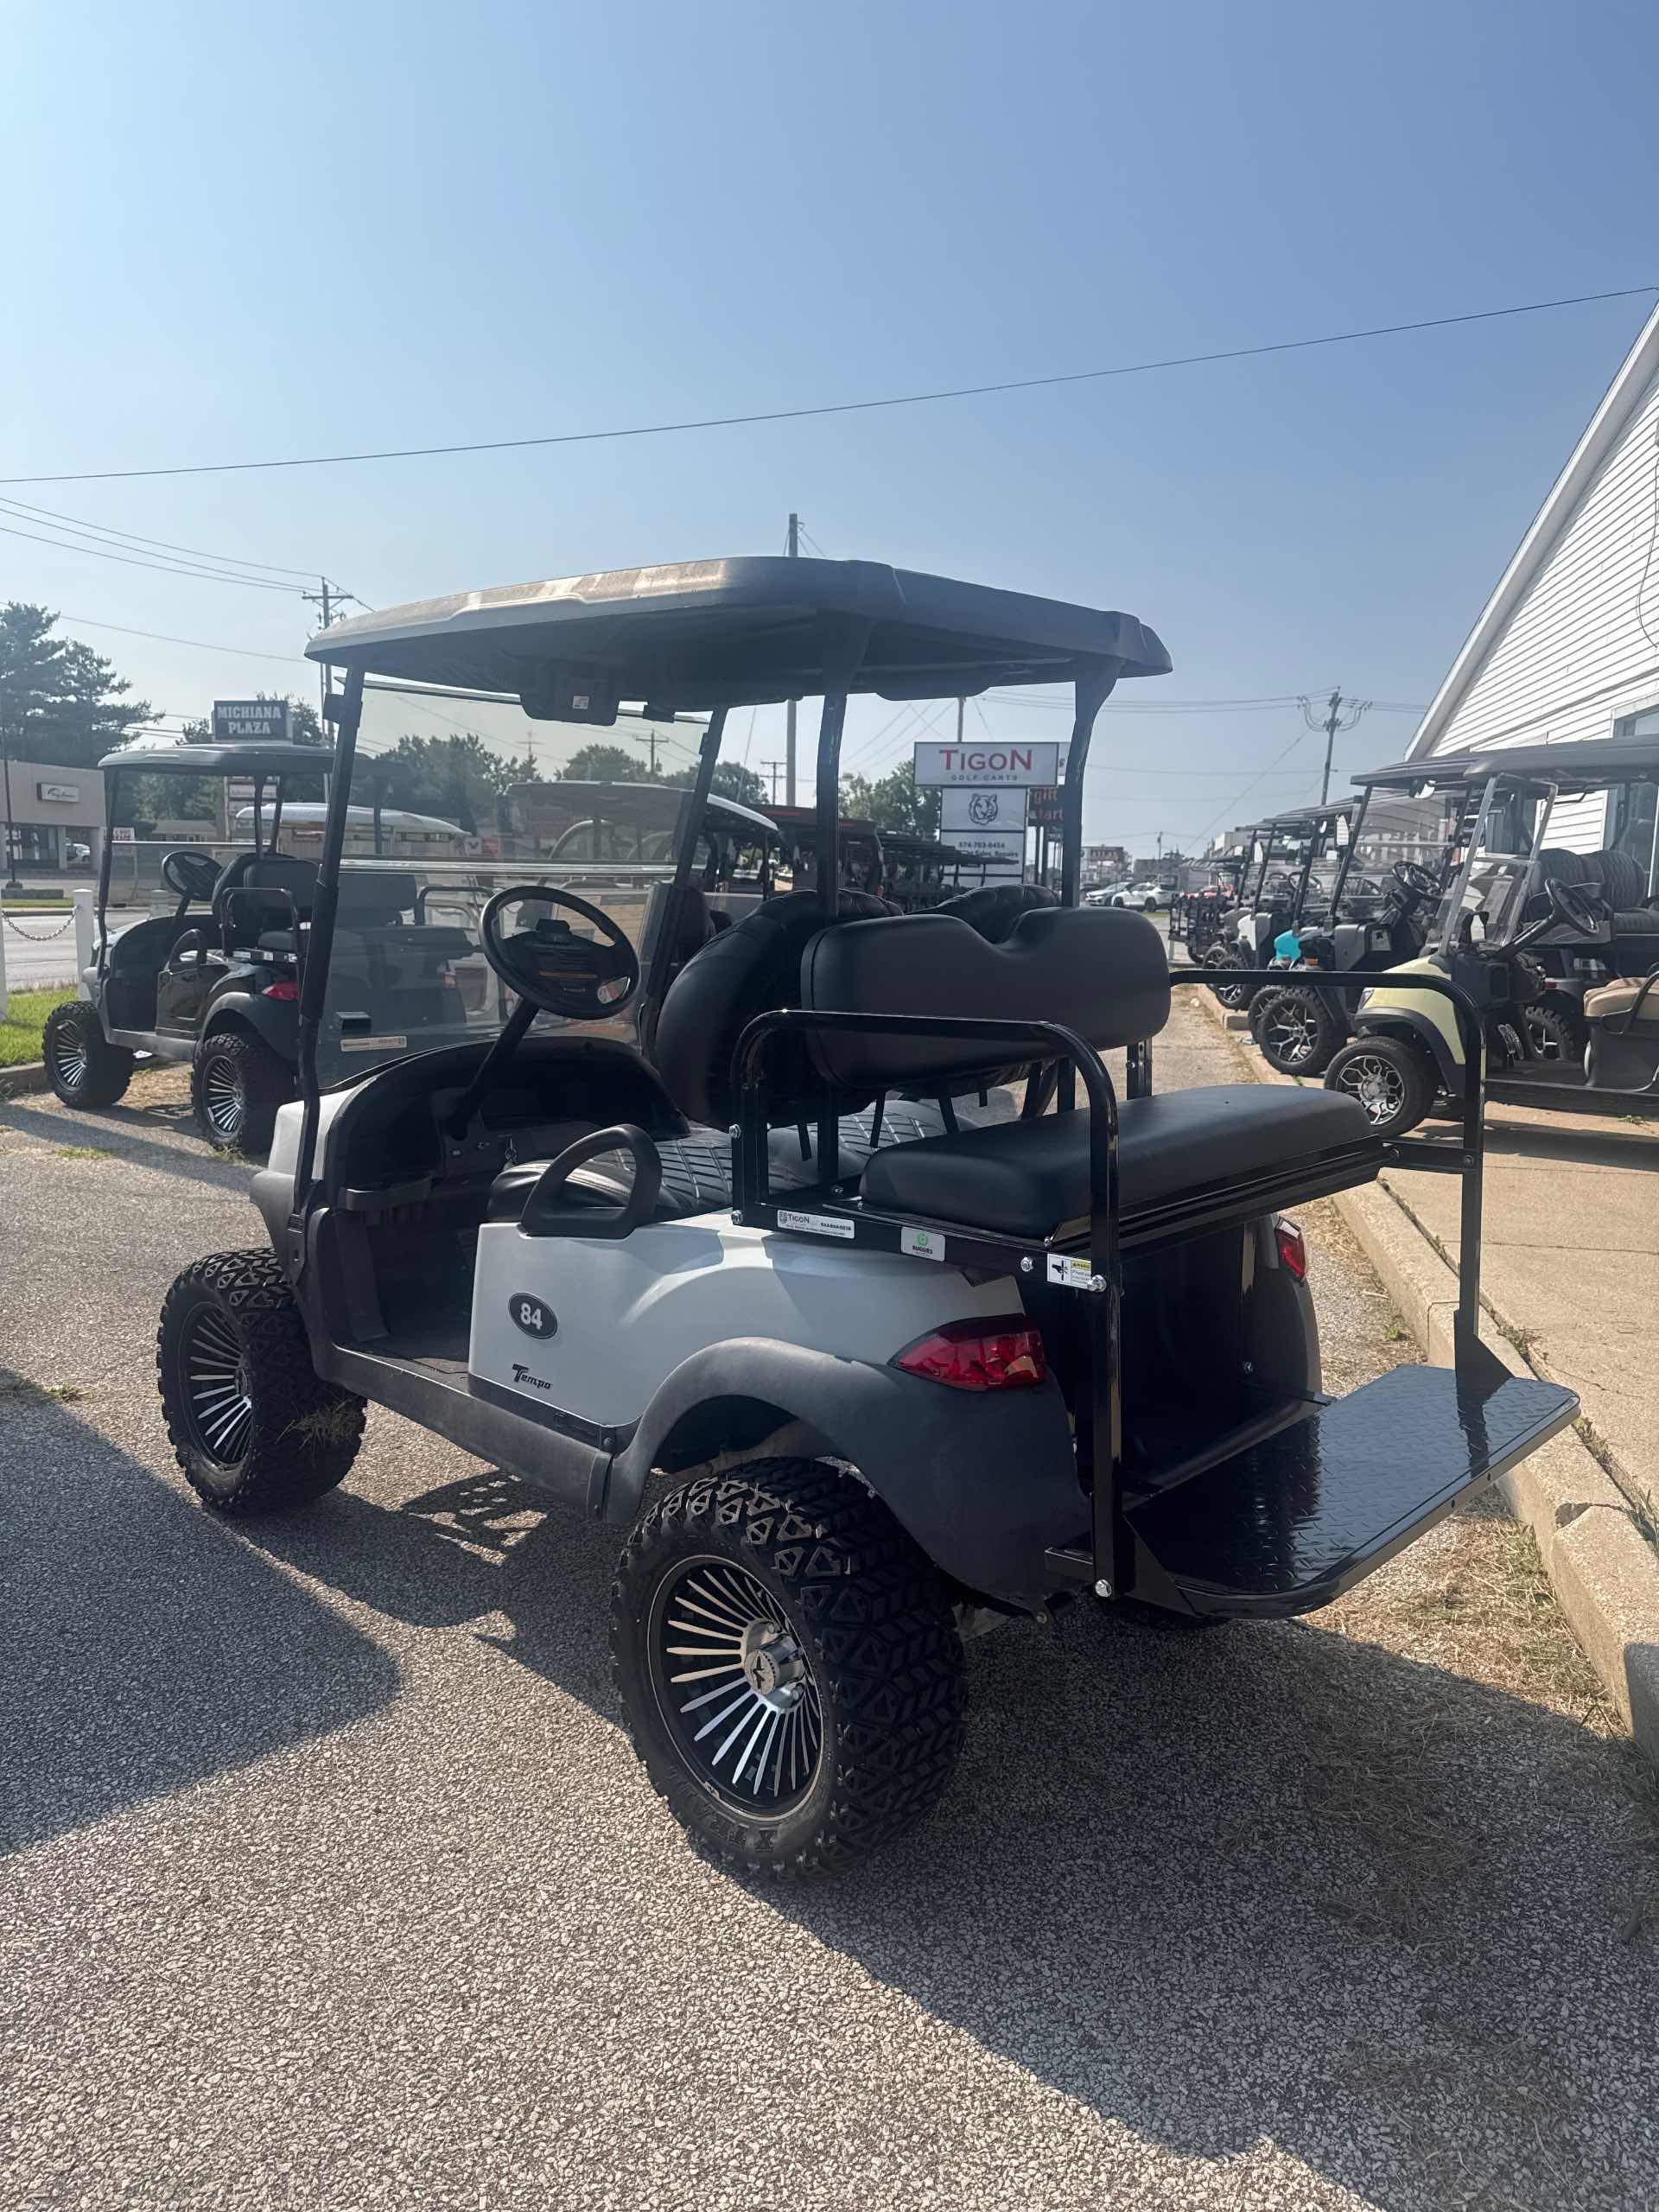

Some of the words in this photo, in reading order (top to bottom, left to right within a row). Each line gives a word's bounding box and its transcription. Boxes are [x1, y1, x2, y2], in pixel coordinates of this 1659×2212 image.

[217, 705, 282, 719] MICHIANA
[228, 721, 270, 734] PLAZA
[939, 749, 1032, 771] TIGON
[787, 1213, 810, 1224] TIGON
[520, 1302, 543, 1330] 84
[512, 1363, 552, 1389] Tempo
